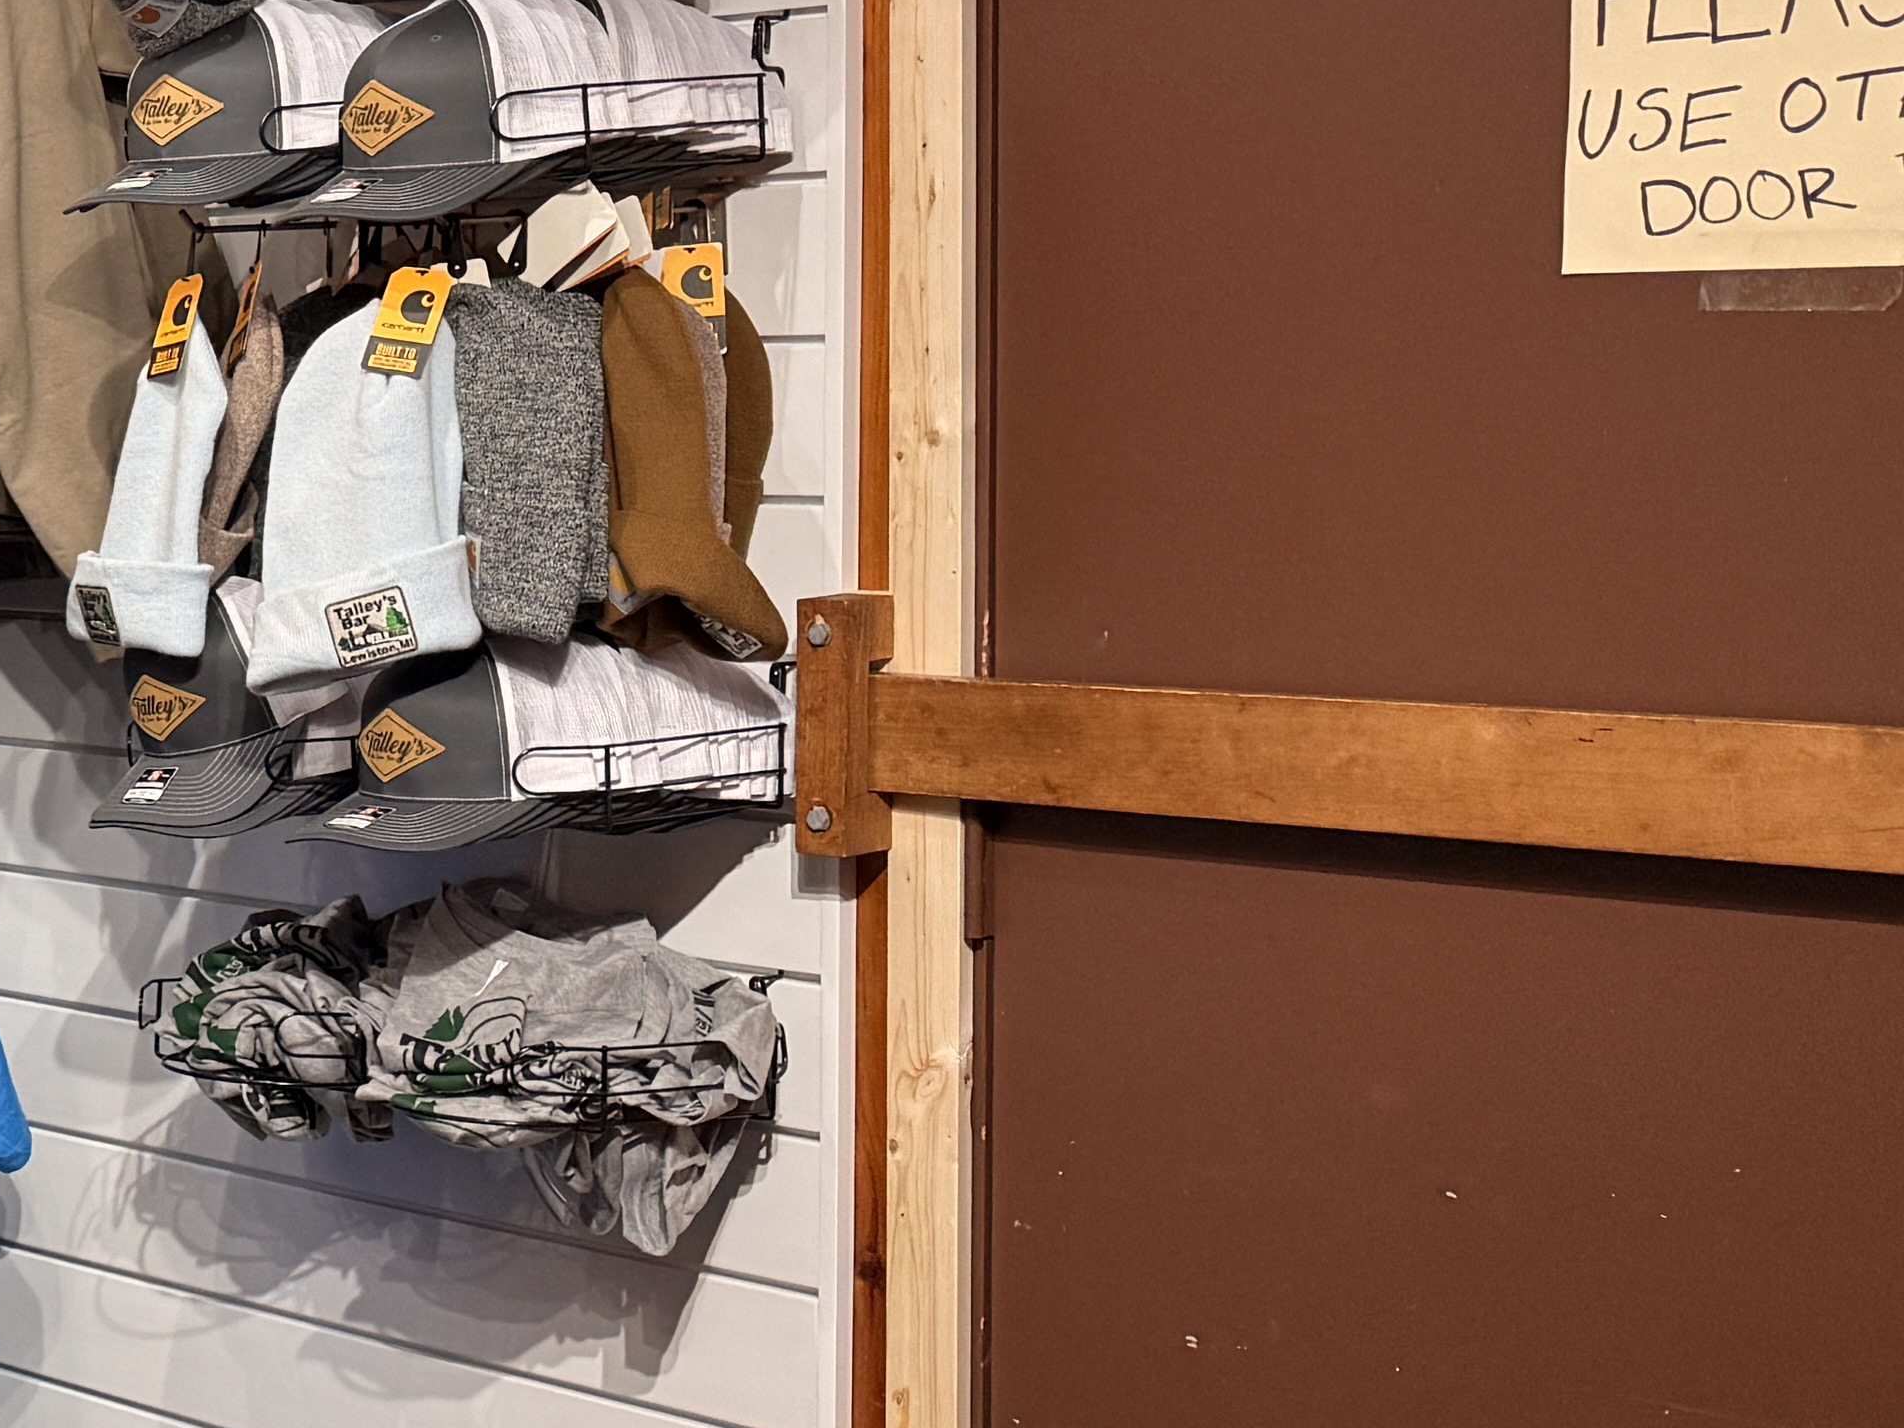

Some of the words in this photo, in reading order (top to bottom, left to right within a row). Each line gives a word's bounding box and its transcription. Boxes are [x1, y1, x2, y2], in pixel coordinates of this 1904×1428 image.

[142, 97, 204, 125] Talley's
[351, 105, 415, 134] Talley's
[1578, 84, 1742, 160] USE
[1640, 168, 1857, 237] DOOR
[333, 594, 397, 620] Talley's
[341, 614, 370, 630] Bar
[132, 695, 187, 722] Talley's
[366, 730, 427, 764] Talley's
